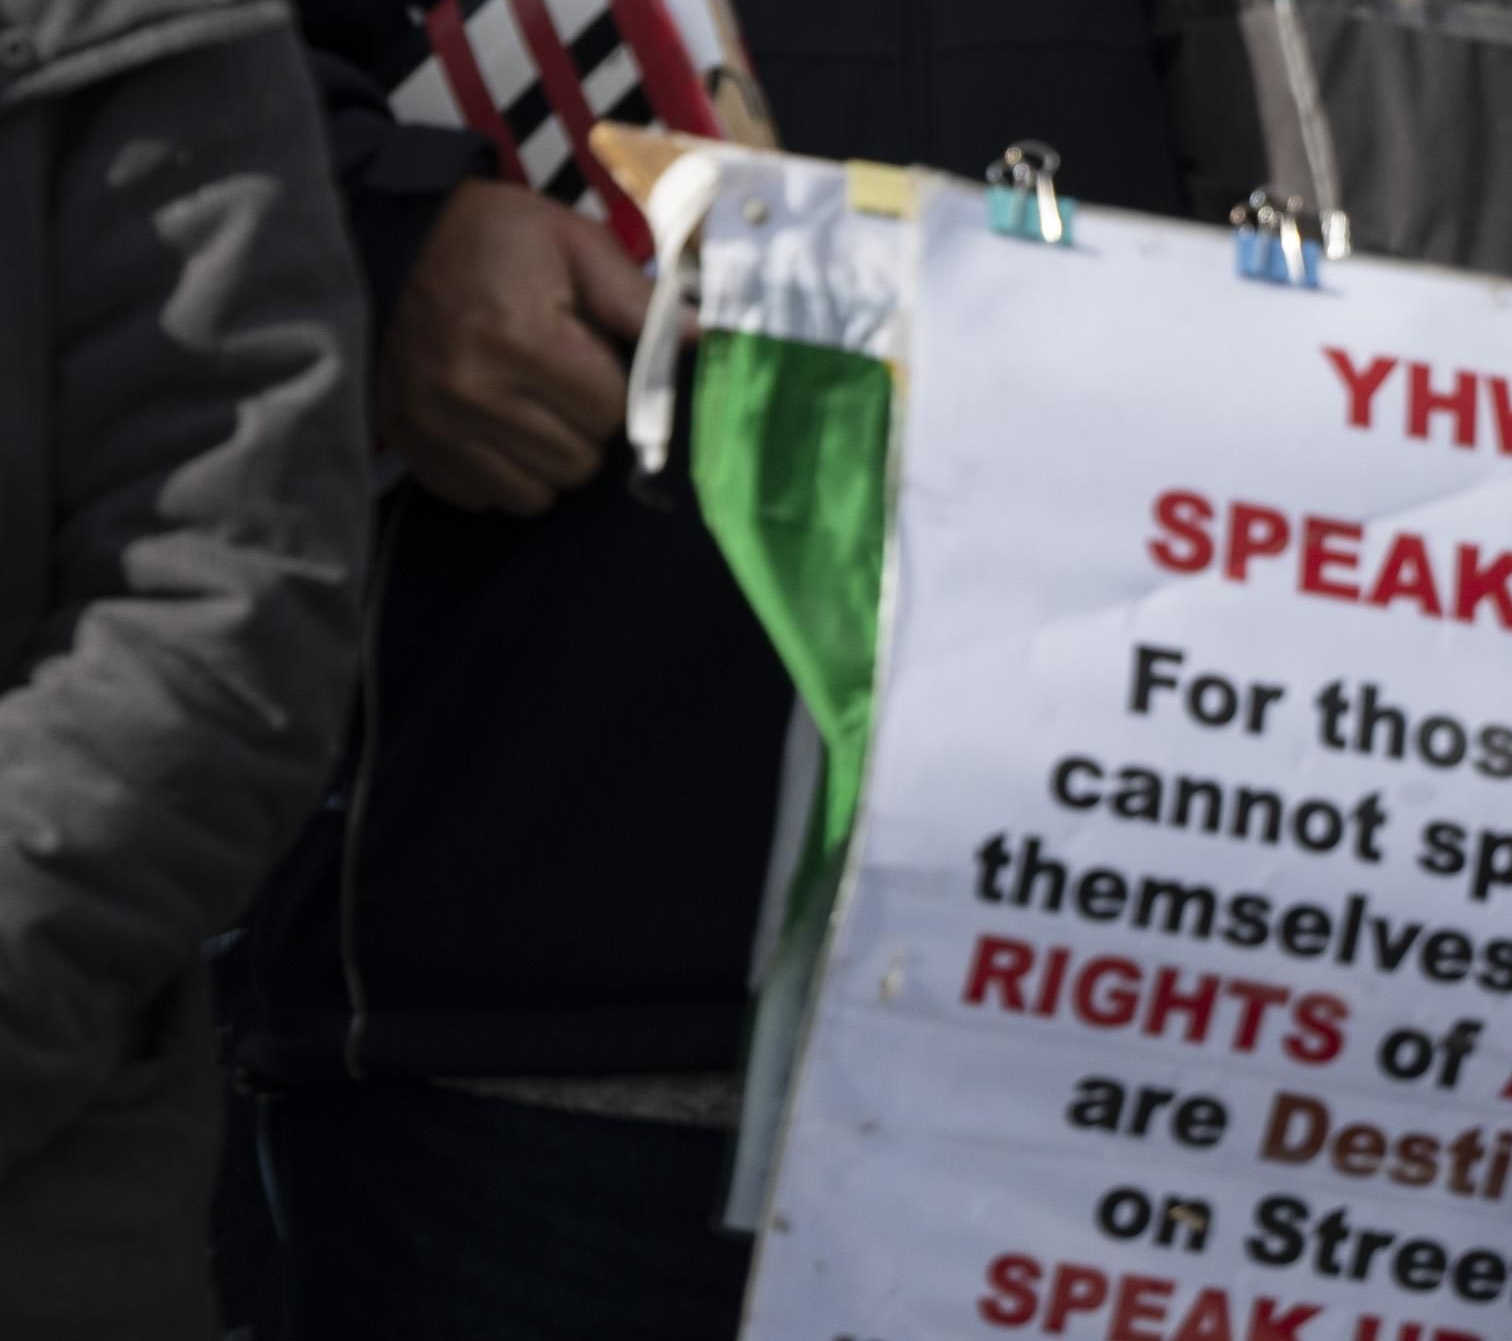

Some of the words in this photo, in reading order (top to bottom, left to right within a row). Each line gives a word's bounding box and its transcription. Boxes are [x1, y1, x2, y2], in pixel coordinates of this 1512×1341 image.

[1130, 645, 1284, 735] For
[1050, 756, 1387, 864] cannot
[963, 935, 1349, 1066] RIGHTS
[1378, 1019, 1484, 1090] of
[1067, 1077, 1229, 1150] are
[1095, 1186, 1213, 1253] on
